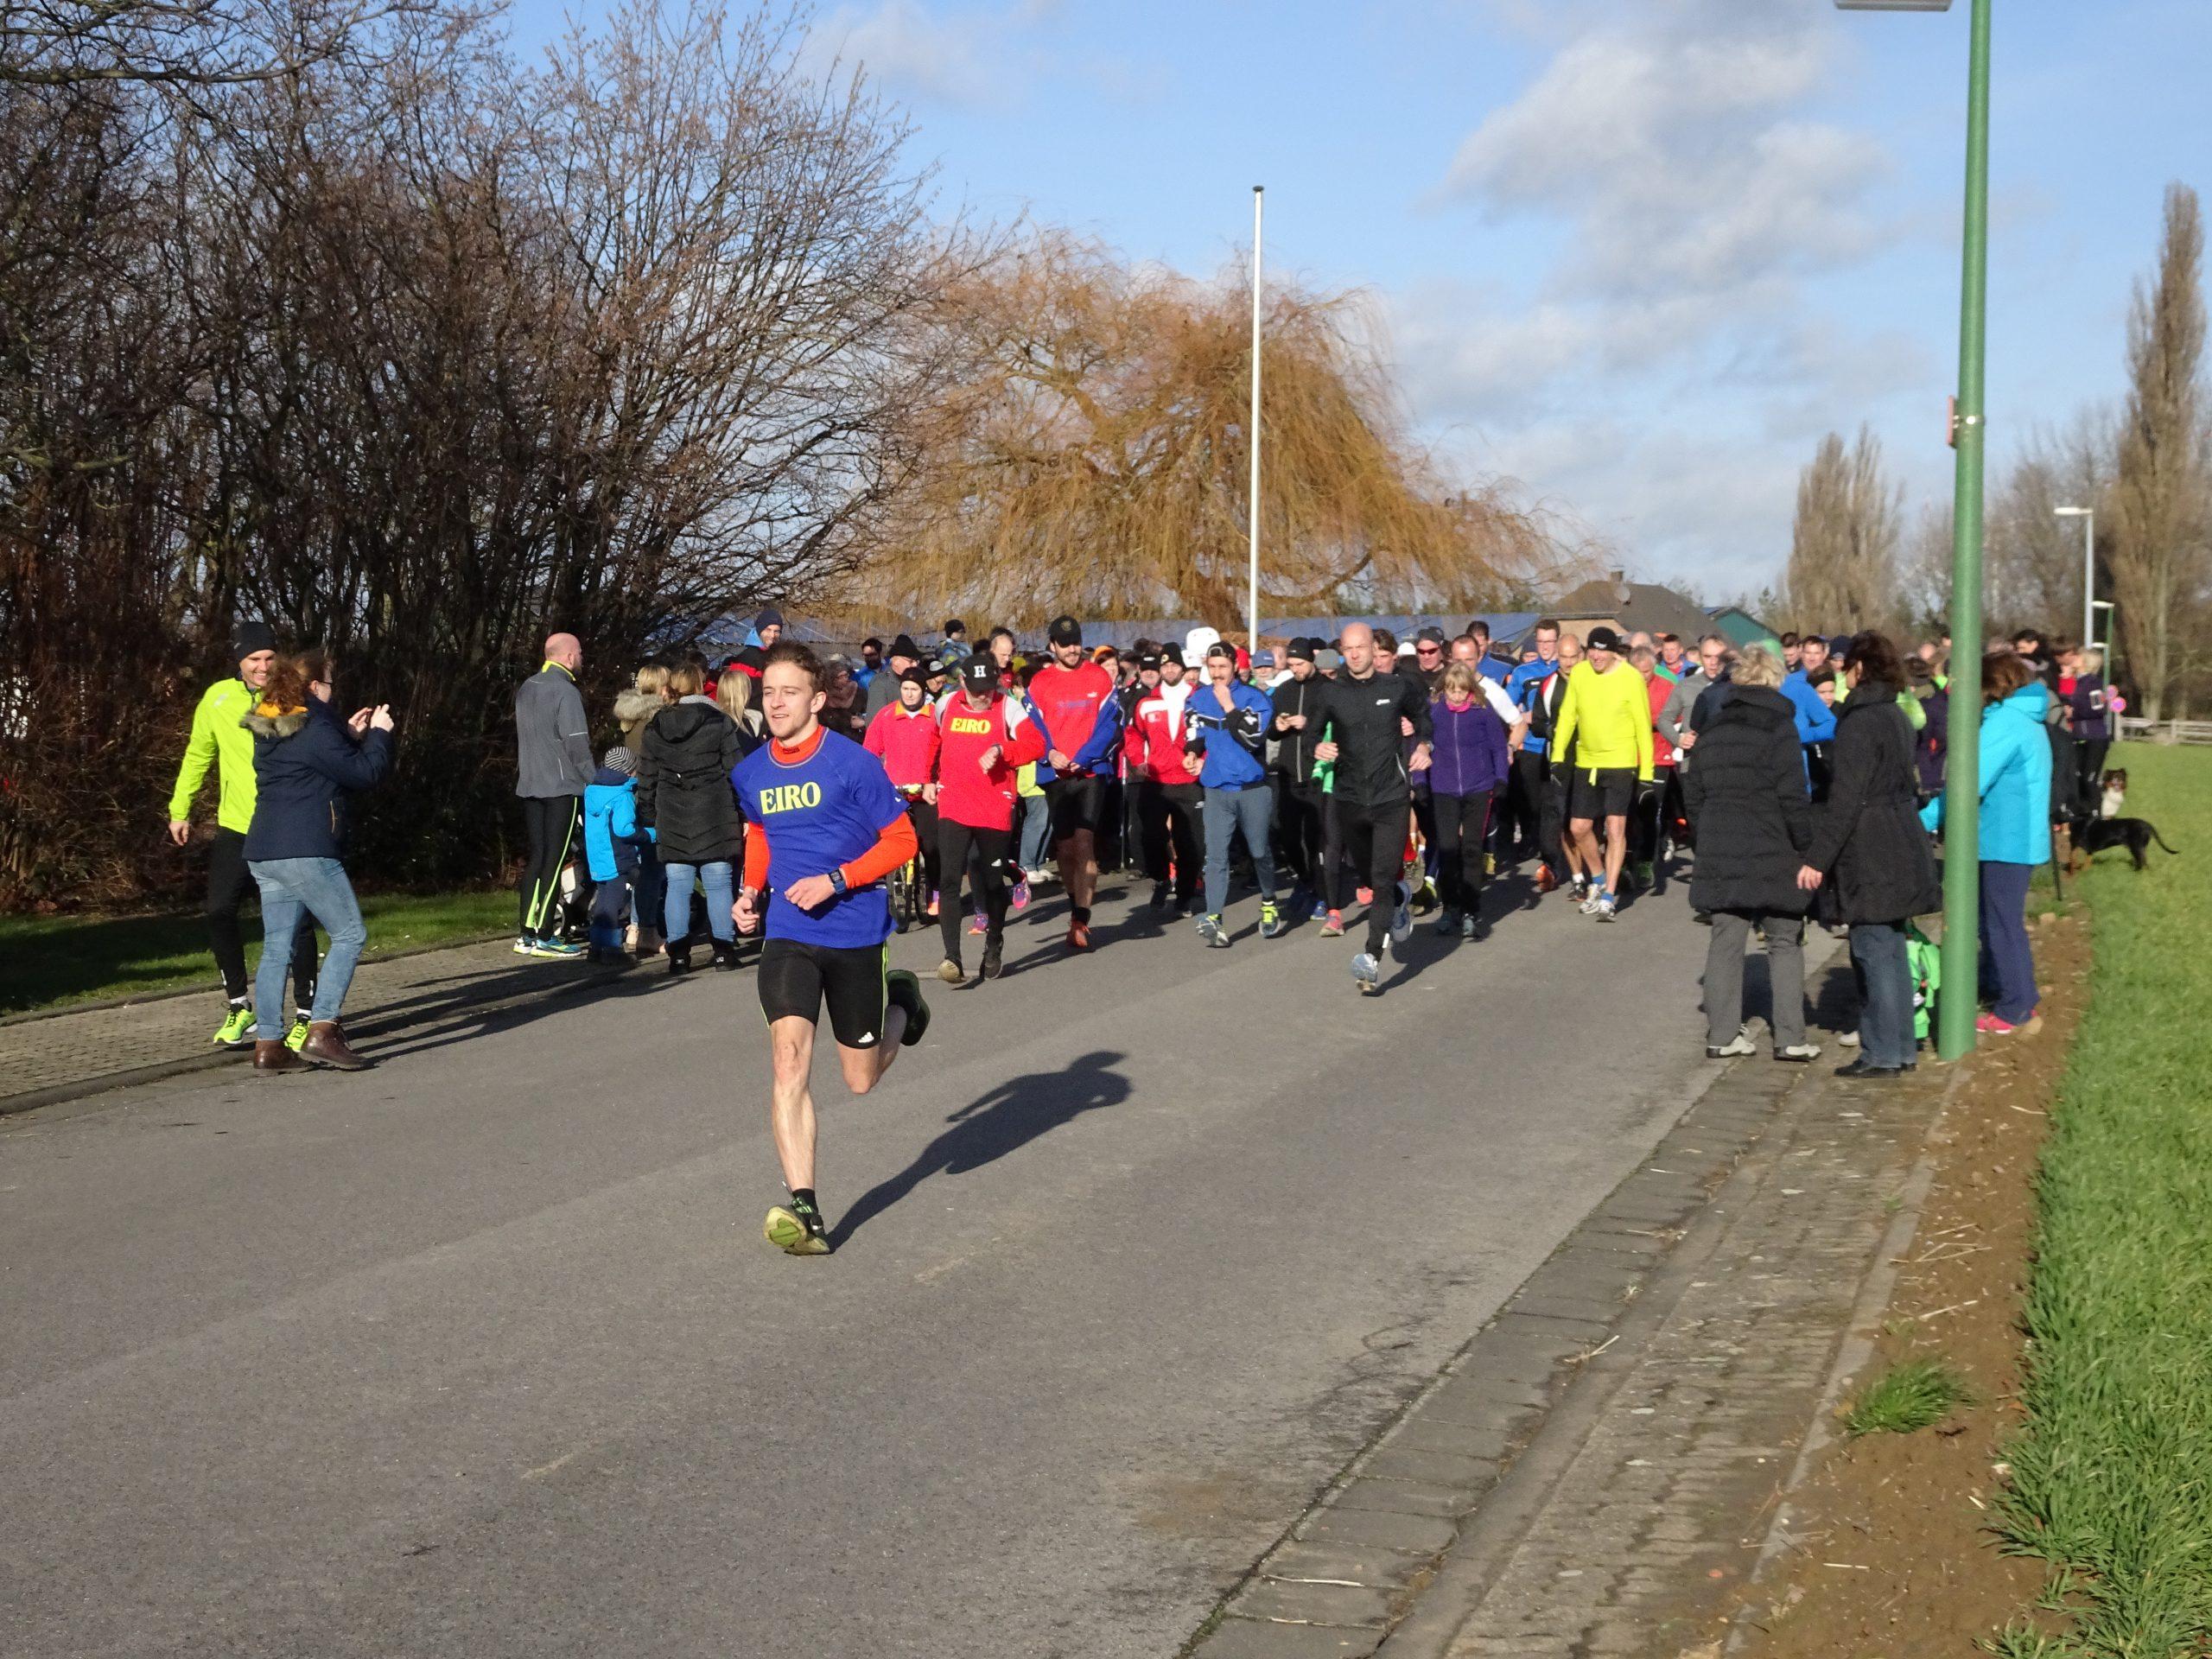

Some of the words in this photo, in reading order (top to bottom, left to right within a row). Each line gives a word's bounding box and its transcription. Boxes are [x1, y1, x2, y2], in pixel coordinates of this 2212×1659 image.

[974, 664, 987, 678] H
[950, 717, 991, 734] EIRO
[760, 781, 821, 815] EIRO
